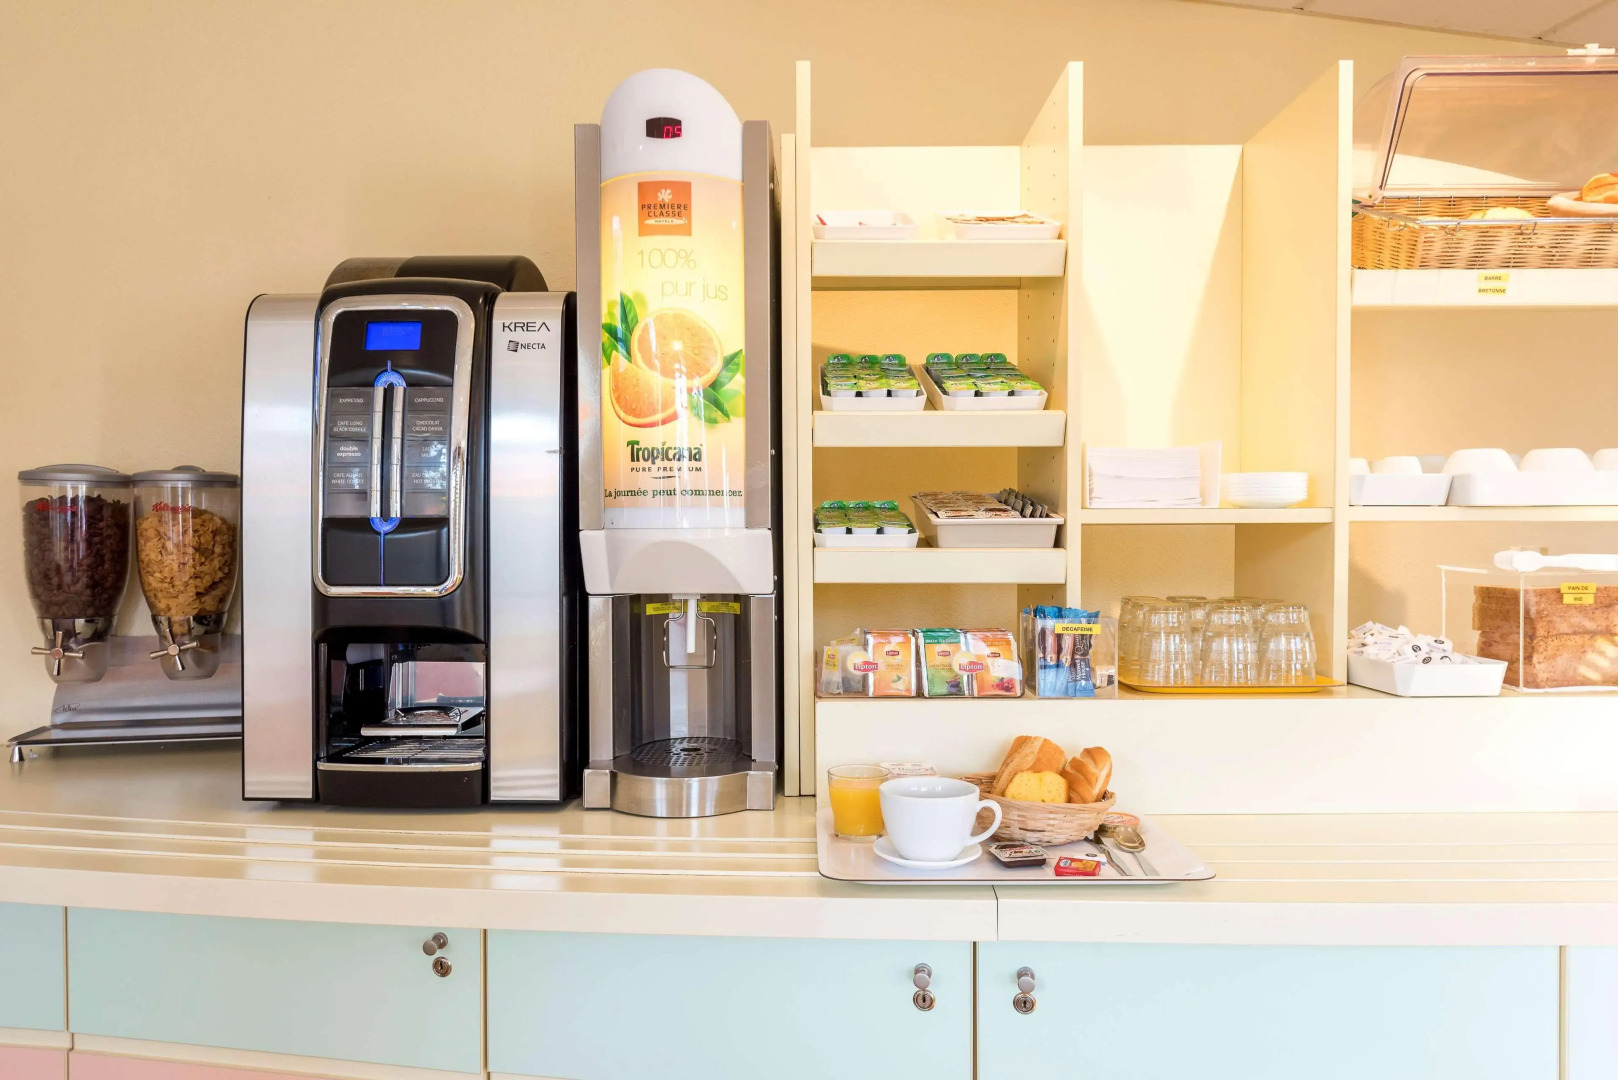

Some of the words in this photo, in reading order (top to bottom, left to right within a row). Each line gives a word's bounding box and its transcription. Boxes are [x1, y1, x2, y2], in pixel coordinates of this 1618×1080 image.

[641, 203, 688, 211] PREMIERE
[637, 248, 697, 270] 100%
[661, 280, 696, 300] pur
[702, 279, 728, 302] jus
[502, 322, 550, 332] KREA
[626, 439, 703, 465] Tropicana
[604, 489, 612, 497] La
[614, 488, 648, 499] journée
[652, 488, 677, 498] peut
